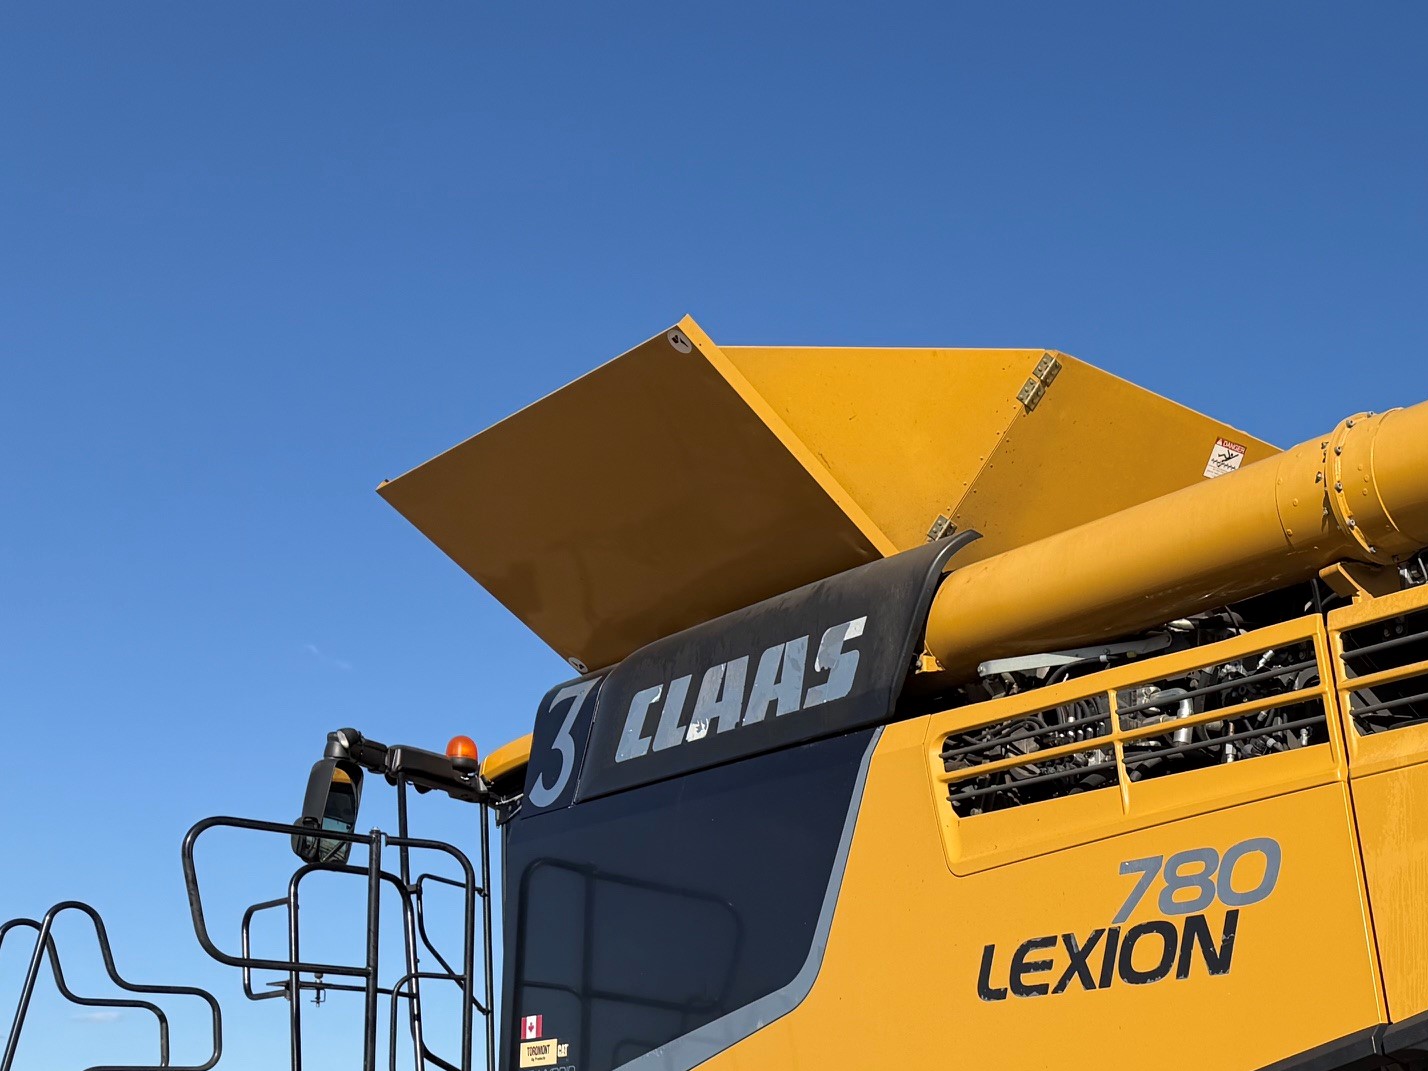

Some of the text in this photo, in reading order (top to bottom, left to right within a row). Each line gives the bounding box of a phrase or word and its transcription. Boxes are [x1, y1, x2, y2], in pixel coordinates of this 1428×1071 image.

[1222, 440, 1246, 454] DANGER
[615, 615, 868, 763] CLAAS
[528, 675, 603, 808] 3
[1111, 837, 1282, 925] 780
[977, 909, 1240, 1002] LEXION
